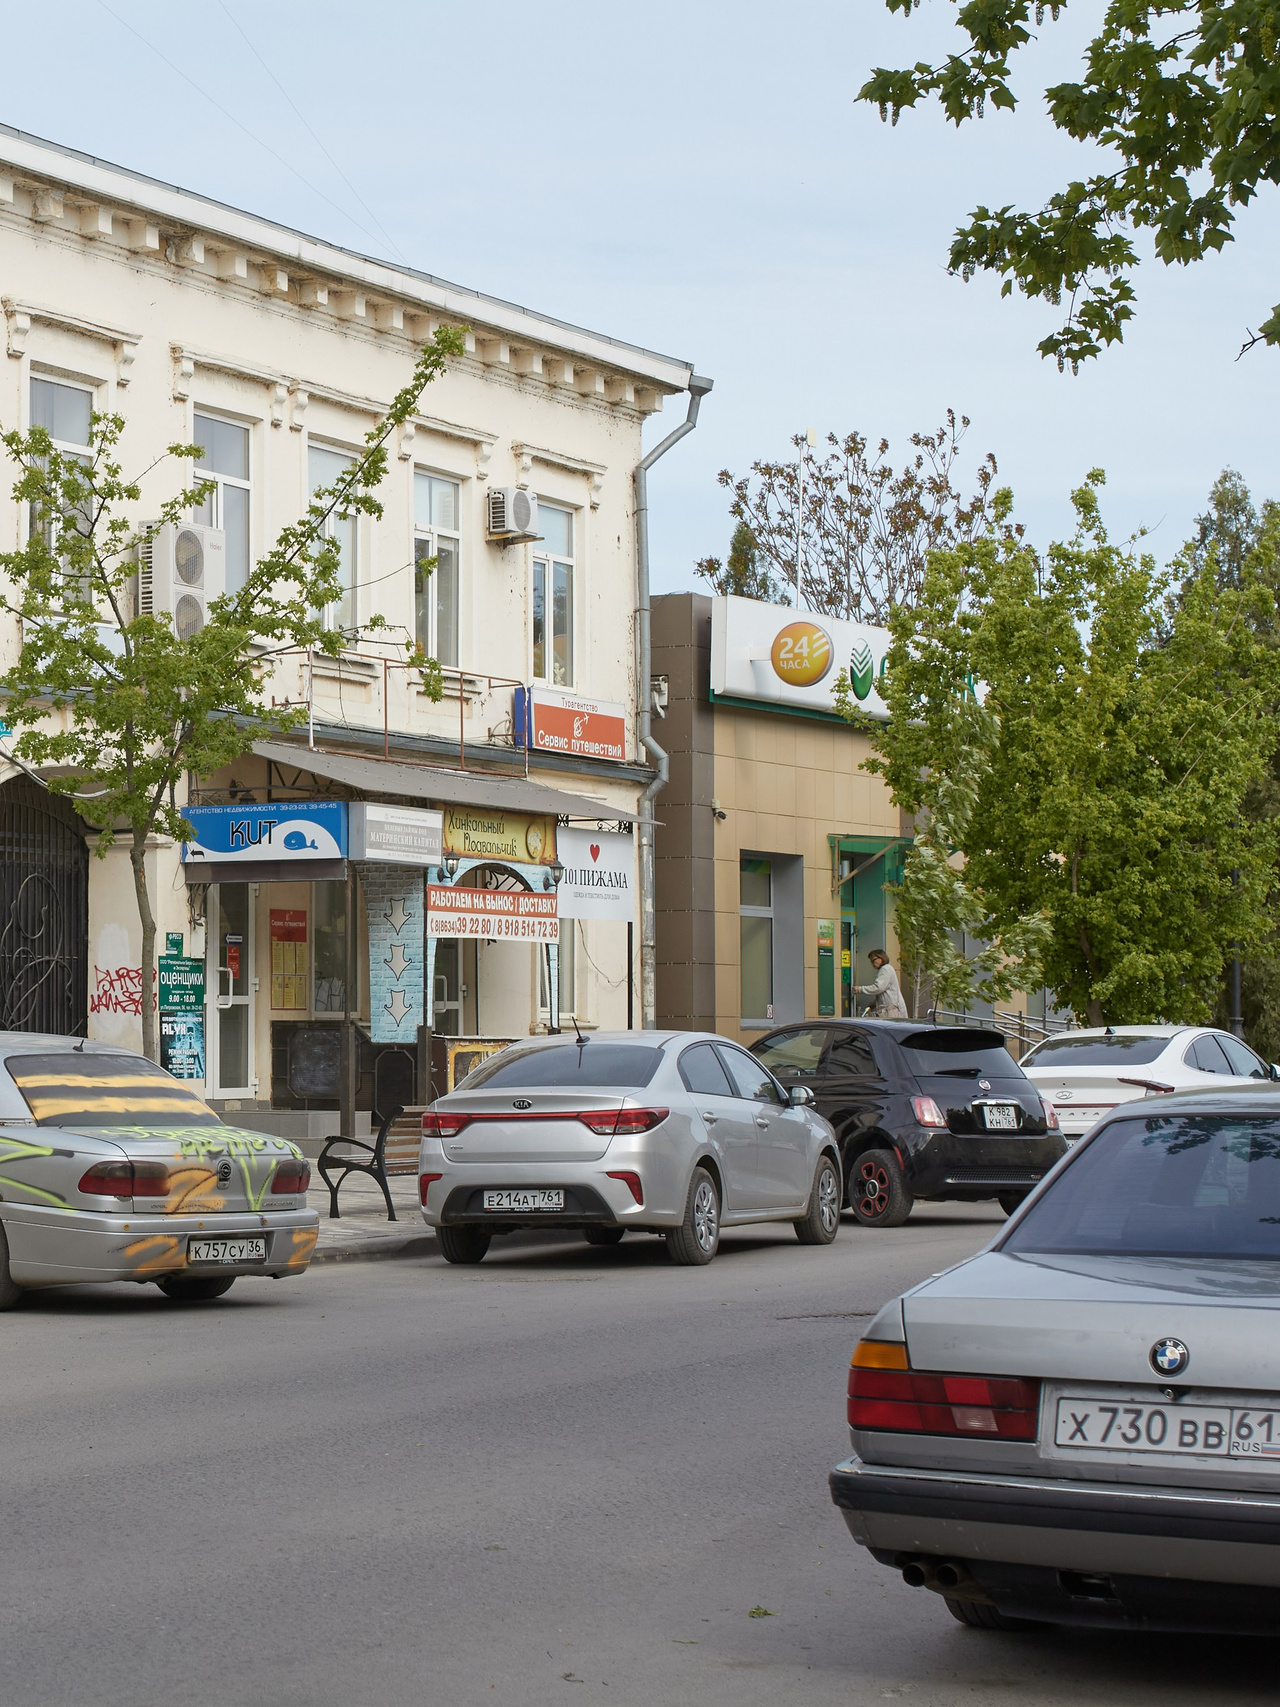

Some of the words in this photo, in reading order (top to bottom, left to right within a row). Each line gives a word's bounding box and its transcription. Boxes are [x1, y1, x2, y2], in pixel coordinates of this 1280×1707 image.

[779, 636, 810, 659] 24
[779, 658, 810, 669] ЧАСА
[561, 697, 599, 713] Турагентство
[538, 729, 569, 749] Сервис
[571, 738, 622, 757] путешествий
[189, 807, 223, 815] АГЕНТСТВО
[224, 805, 276, 814] НЕДВИЖИМОСТИ
[448, 809, 505, 835] Хинкальный
[370, 832, 413, 846] МАТЕРИНСКИЙ
[463, 832, 518, 858] Подвальчик
[564, 868, 578, 884] 101
[580, 869, 628, 888] ПИЖАМА
[430, 890, 472, 908] РАБОТАЕМ
[473, 895, 485, 910] НА
[485, 895, 514, 911] ВЫНОС
[519, 897, 557, 915] ДОСТАВКУ
[469, 918, 480, 933] 22
[481, 918, 491, 934] 80
[497, 919, 503, 935] 8
[504, 919, 519, 936] 918
[521, 919, 536, 937] 514
[538, 921, 547, 937] 72
[549, 921, 559, 938] 39
[996, 1107, 1011, 1117] 982
[989, 1119, 1001, 1128] КН
[487, 1192, 538, 1207] Е214АТ
[540, 1191, 561, 1202] 761
[194, 1242, 245, 1259] К757СУ
[248, 1240, 261, 1253] 36
[1068, 1406, 1223, 1450] Х730ВВ
[1235, 1411, 1274, 1442] 61
[1231, 1441, 1260, 1453] RUS
